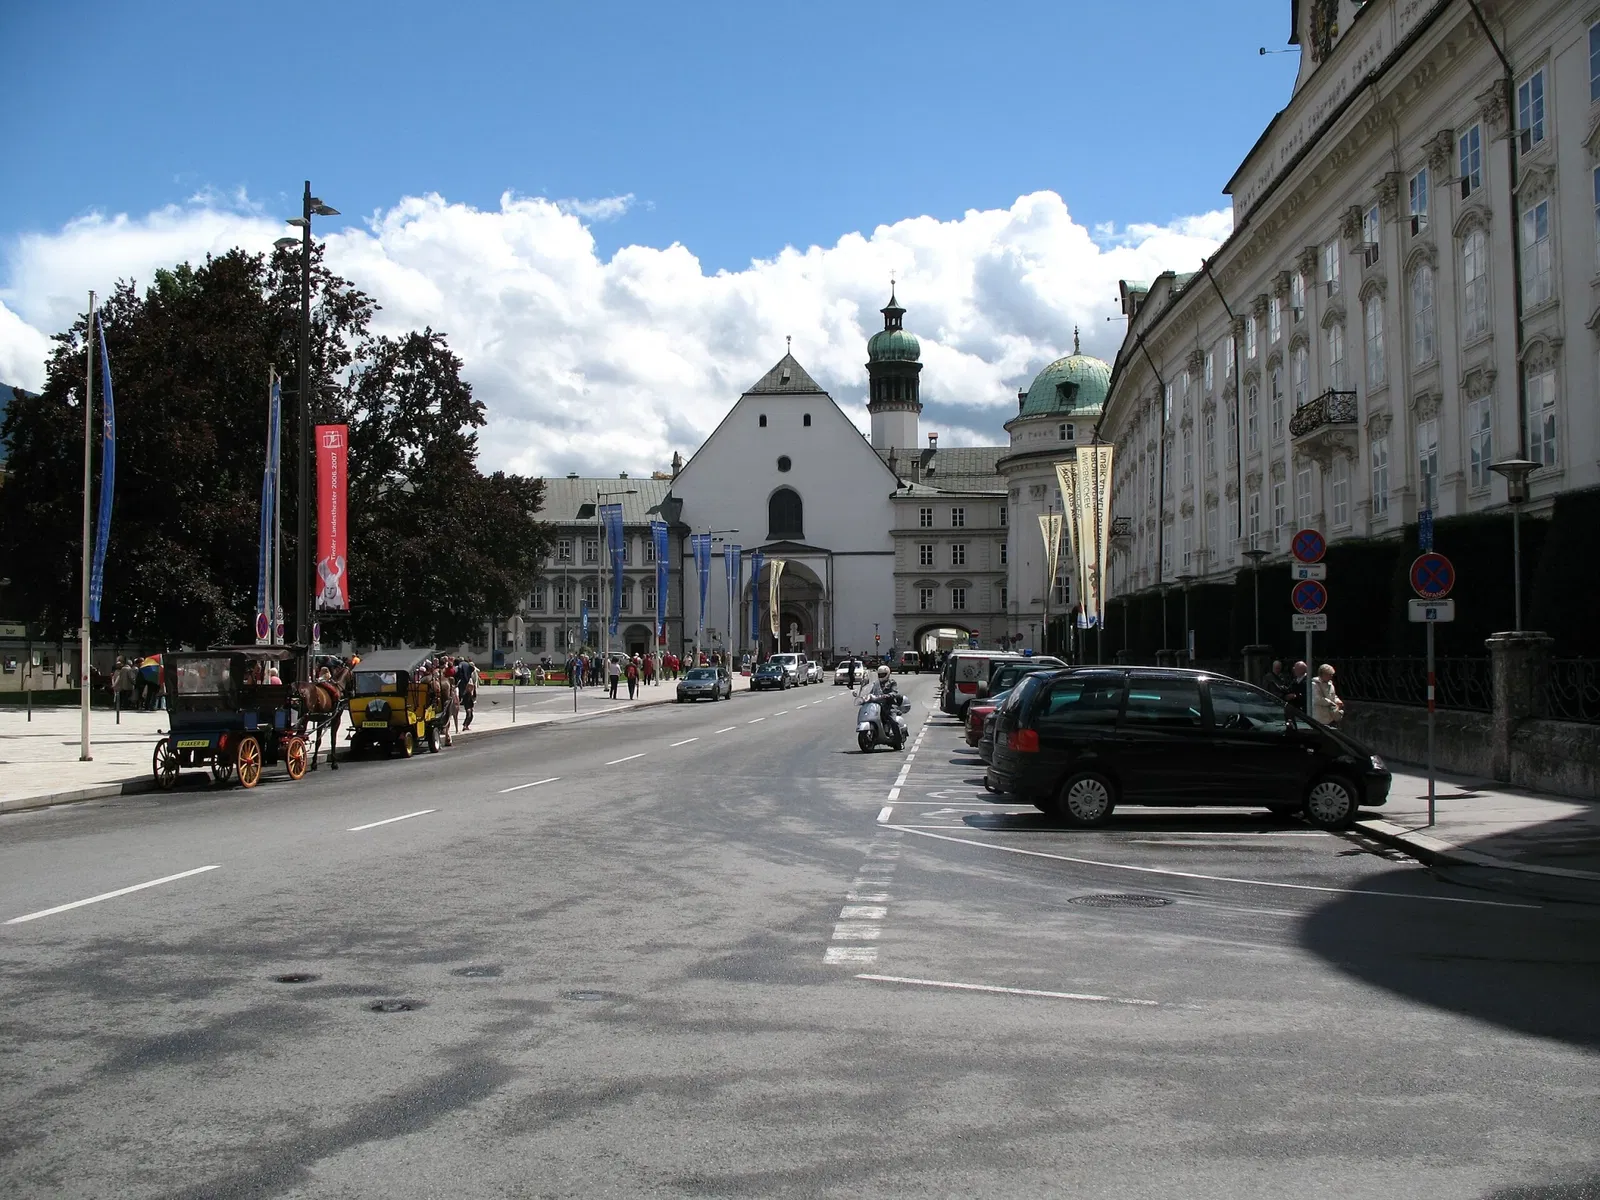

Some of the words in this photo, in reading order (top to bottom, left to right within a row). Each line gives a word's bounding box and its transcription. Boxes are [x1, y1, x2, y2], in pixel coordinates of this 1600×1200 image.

[330, 491, 338, 537] Landestheater
[330, 538, 338, 561] Tiroler
[1419, 589, 1446, 597] ANFANG
